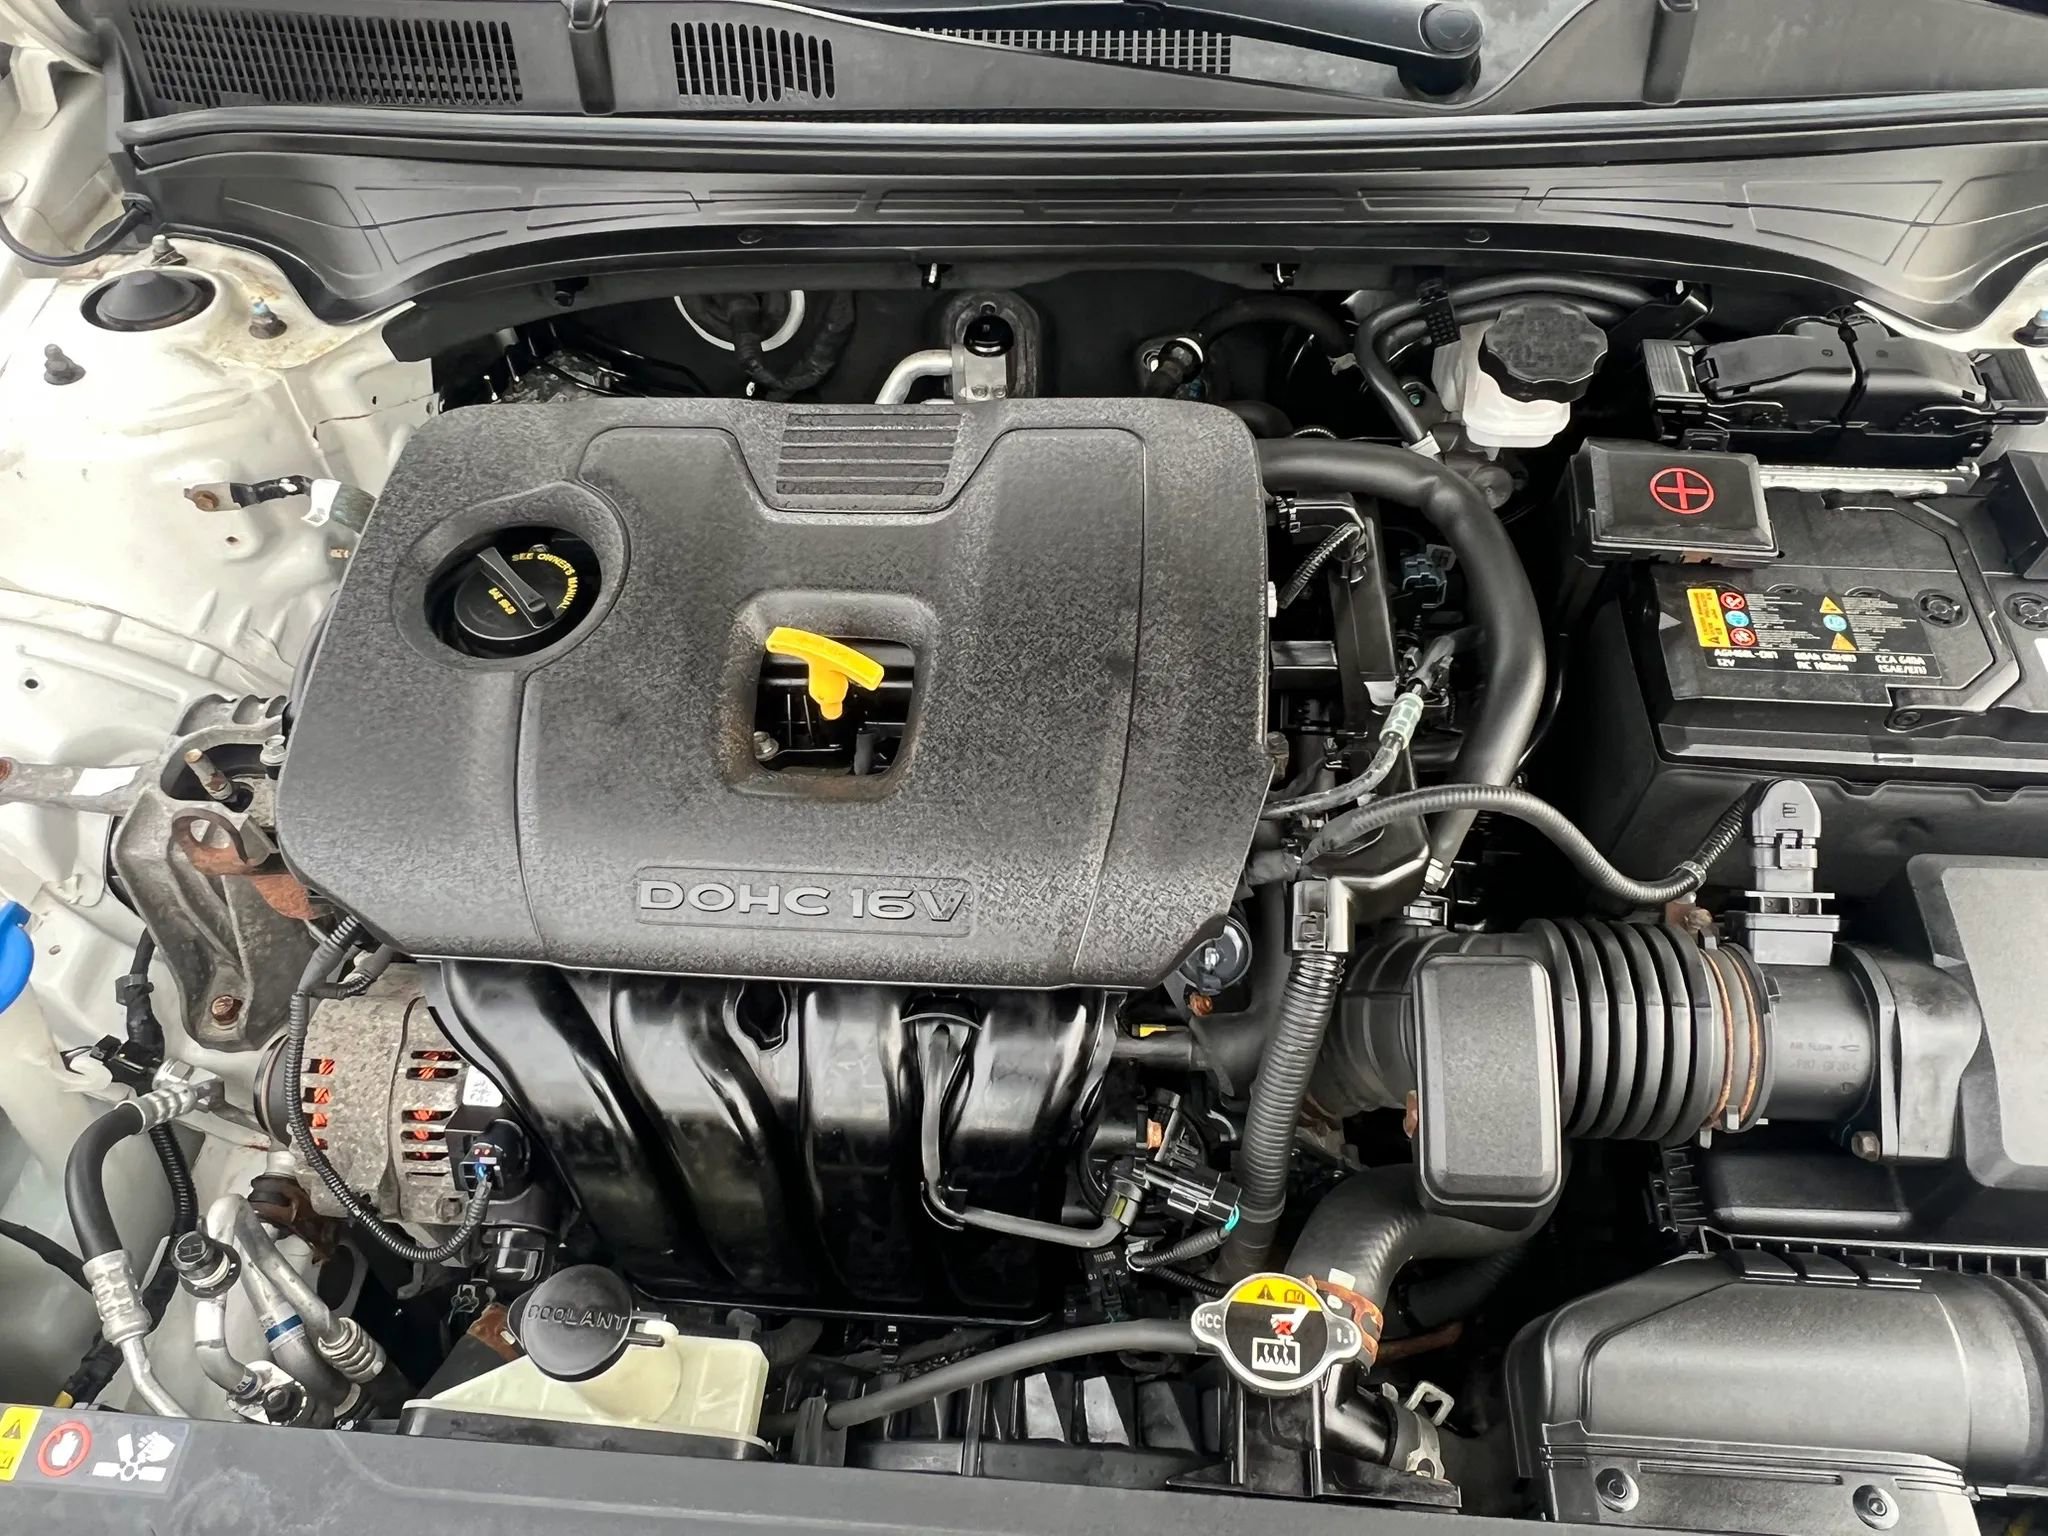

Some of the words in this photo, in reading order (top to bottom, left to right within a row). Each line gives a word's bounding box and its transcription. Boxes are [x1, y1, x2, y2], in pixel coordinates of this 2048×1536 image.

[511, 552, 534, 562] SEE
[537, 553, 576, 576] OWNER'S
[556, 576, 579, 610] MANUAL
[1715, 658, 1736, 667] 12V
[1874, 654, 1898, 664] CCA
[639, 879, 831, 916] DOHC
[851, 888, 967, 922] 16V
[527, 1303, 630, 1331] COOLANT
[1195, 1312, 1223, 1330] HCC
[1336, 1327, 1354, 1345] 1.1
